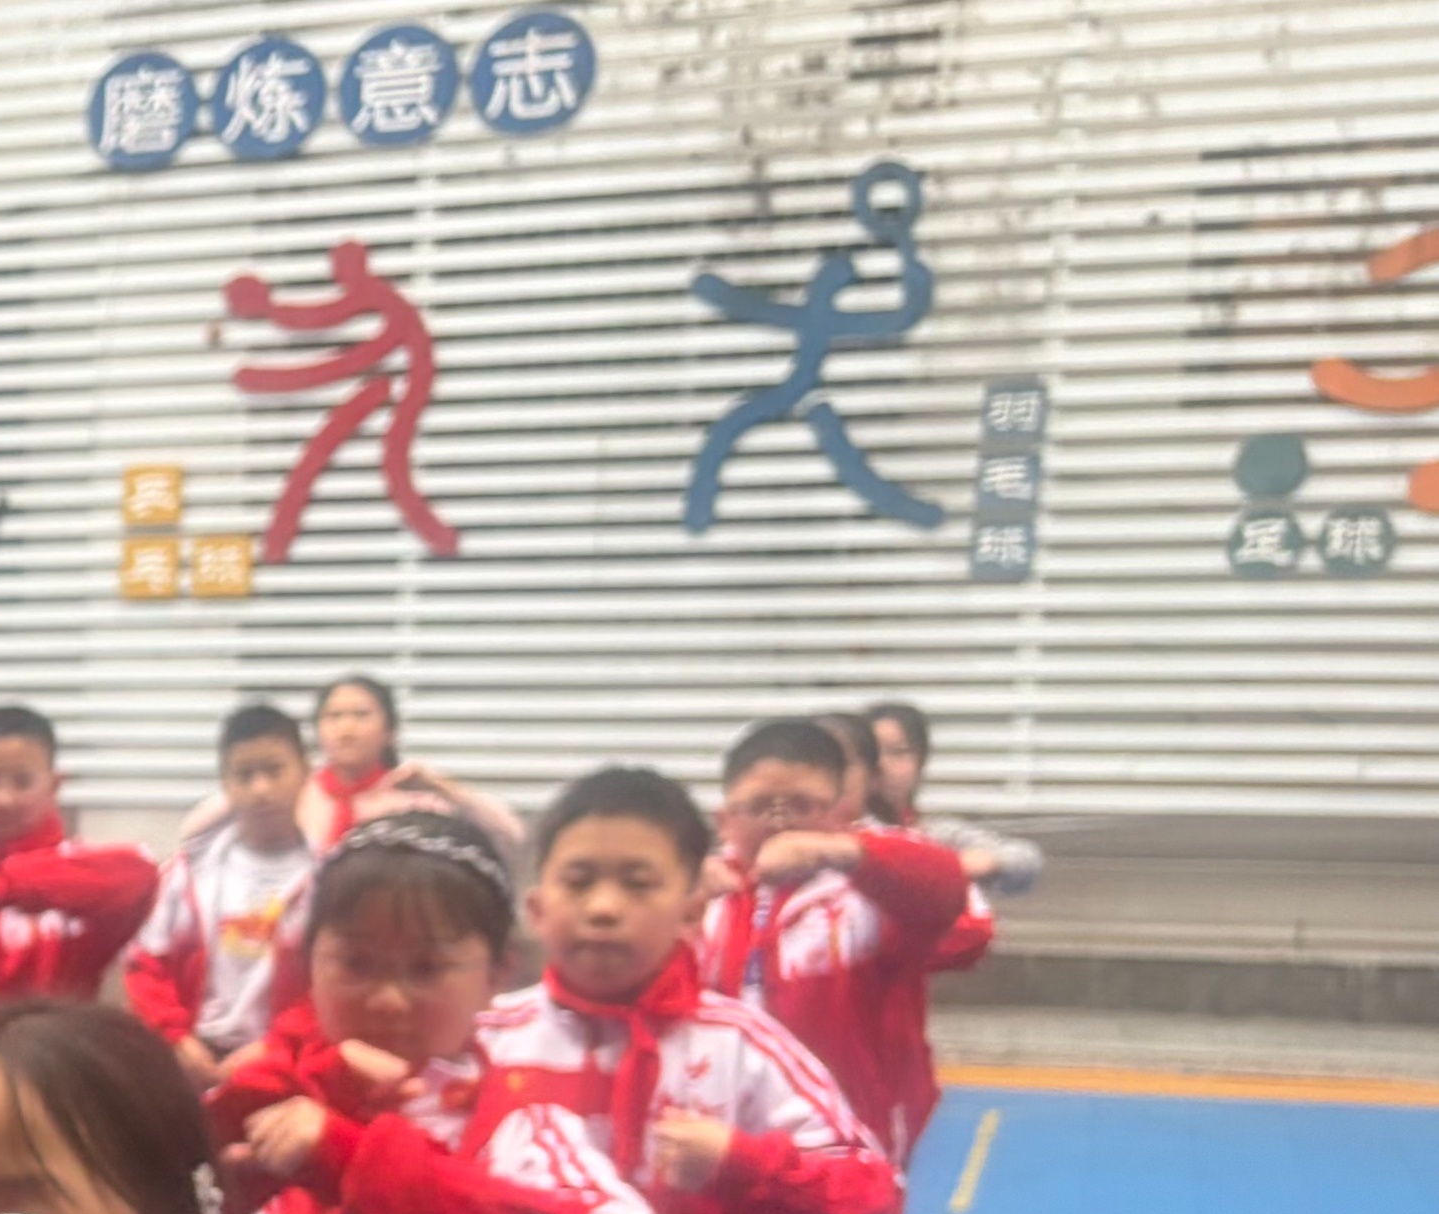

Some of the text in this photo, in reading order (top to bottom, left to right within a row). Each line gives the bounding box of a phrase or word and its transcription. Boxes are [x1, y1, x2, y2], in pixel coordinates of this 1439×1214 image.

[98, 28, 578, 156] 磨炼意志
[975, 389, 1042, 566] 羽毛球
[1235, 516, 1384, 568] 足球
